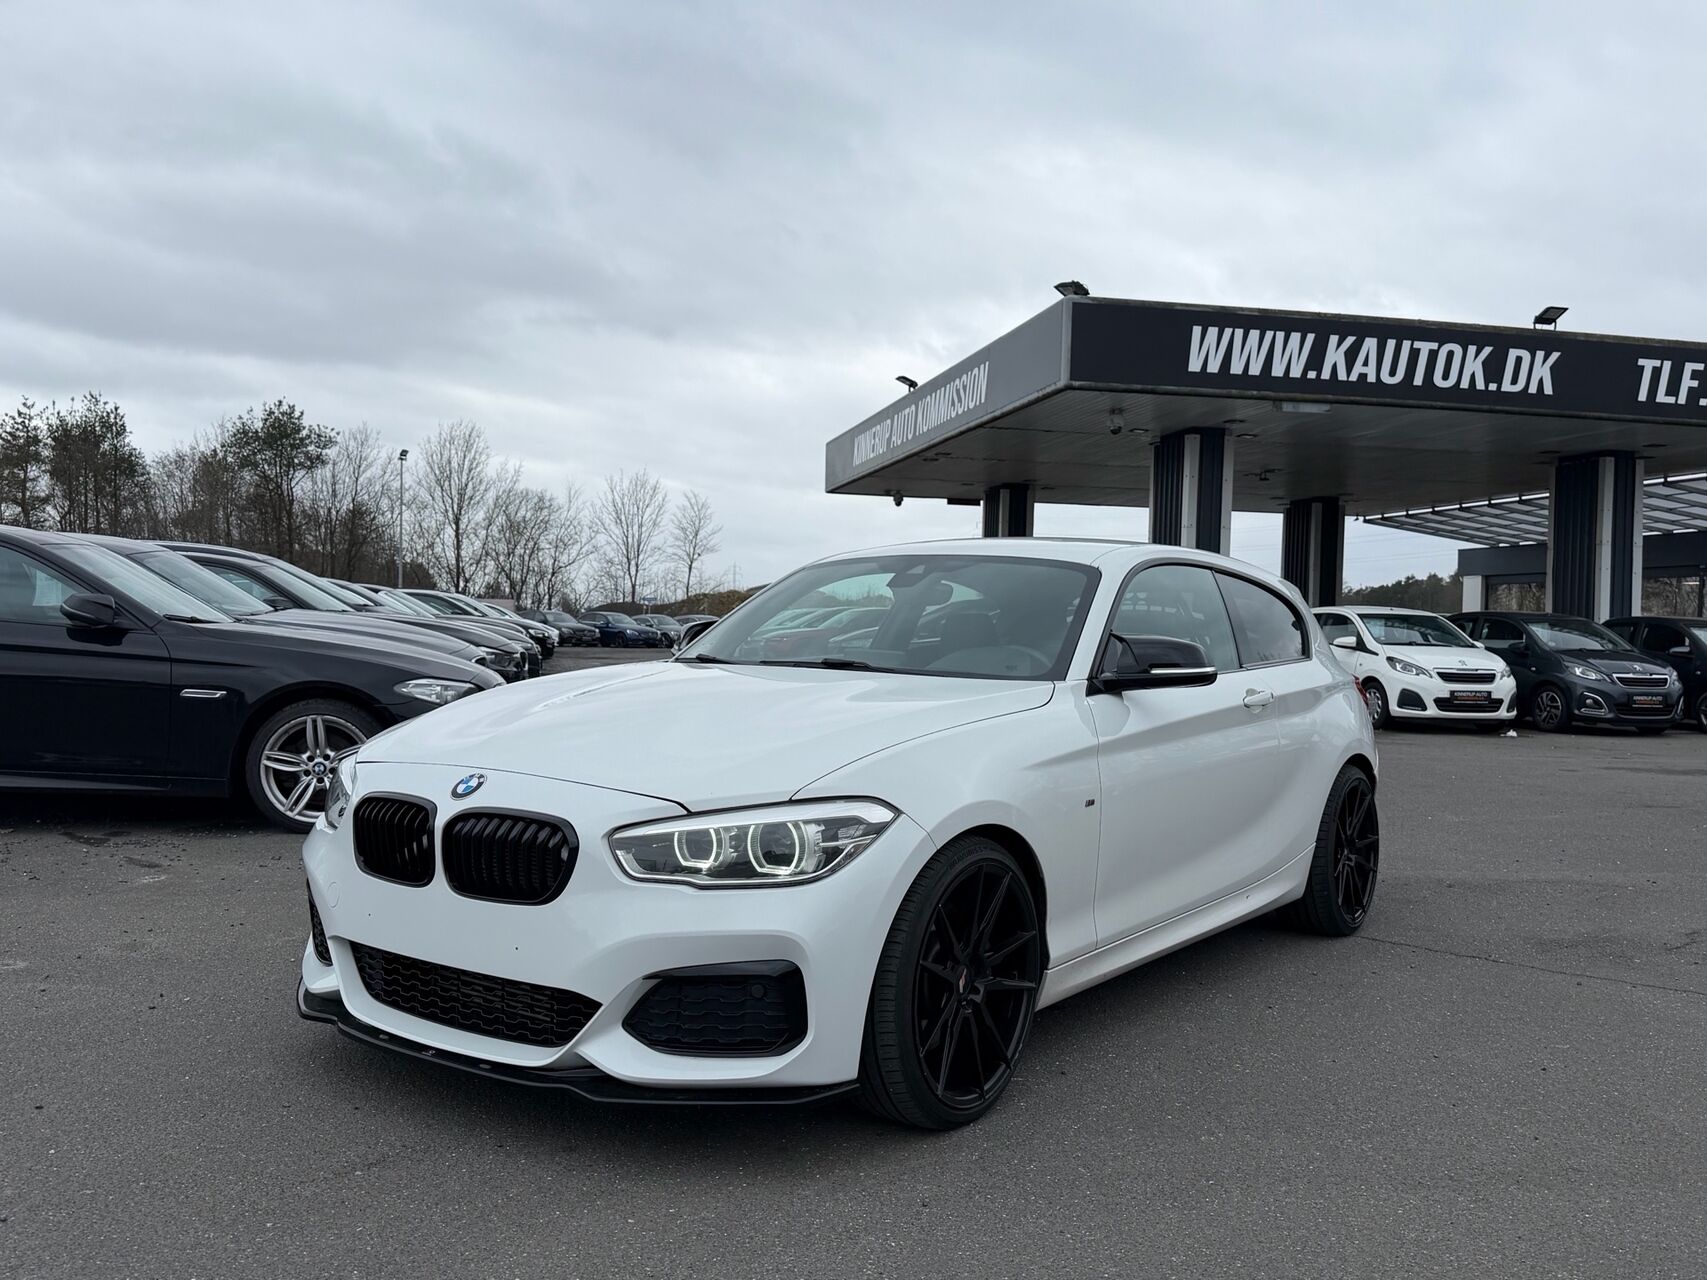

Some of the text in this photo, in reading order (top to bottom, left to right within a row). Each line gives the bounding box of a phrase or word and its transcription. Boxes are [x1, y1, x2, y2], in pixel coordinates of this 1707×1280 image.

[1187, 325, 1561, 395] WWW.KAUTOK.DK
[1637, 358, 1707, 406] TLF.
[853, 361, 989, 467] KINNERUP AUTO KOMMISSION
